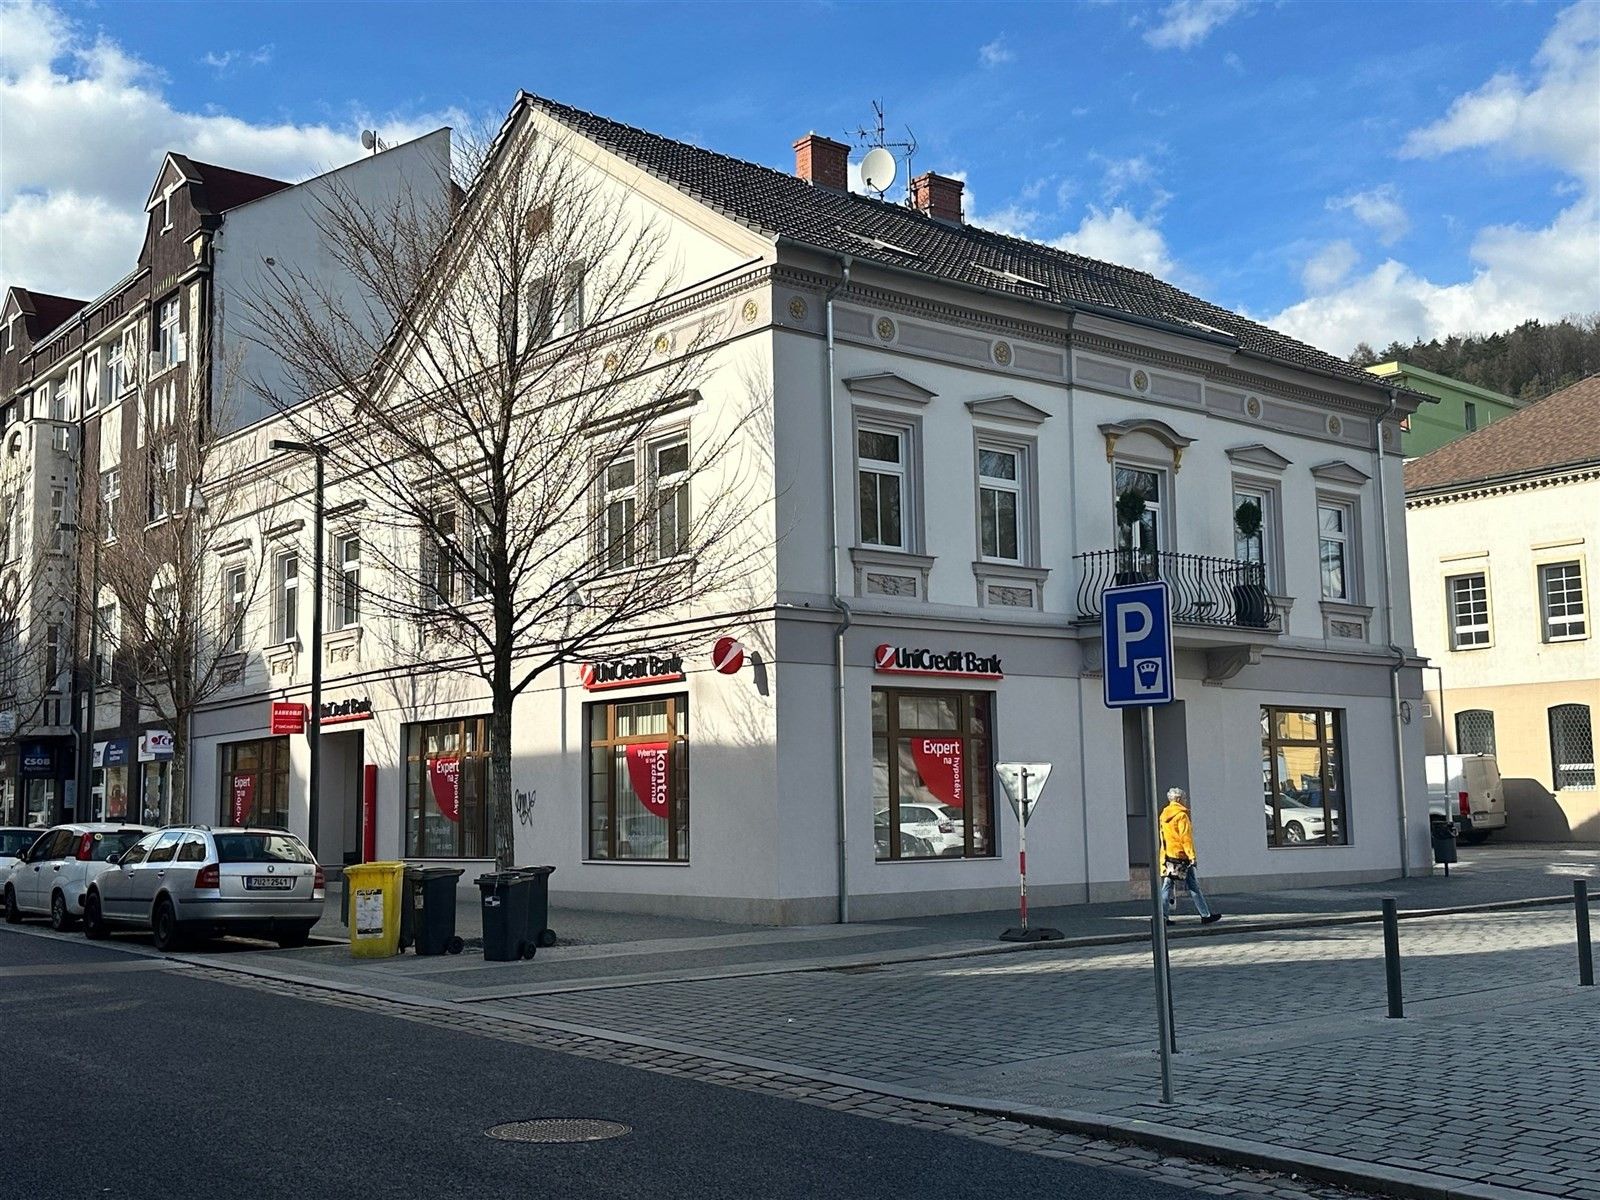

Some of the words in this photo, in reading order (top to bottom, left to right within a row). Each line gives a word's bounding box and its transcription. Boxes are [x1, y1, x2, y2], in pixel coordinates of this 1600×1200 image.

[1117, 602, 1153, 668] P
[596, 658, 648, 682] UniCredit
[649, 653, 684, 676] Bank
[895, 647, 963, 671] UniCredit
[964, 652, 1003, 674] Bank
[923, 740, 960, 757] Expert
[436, 760, 460, 776] Expert
[943, 757, 953, 765] na
[234, 776, 251, 789] Expert
[447, 774, 454, 782] na
[656, 749, 668, 804] konto
[953, 757, 962, 799] hypotéky
